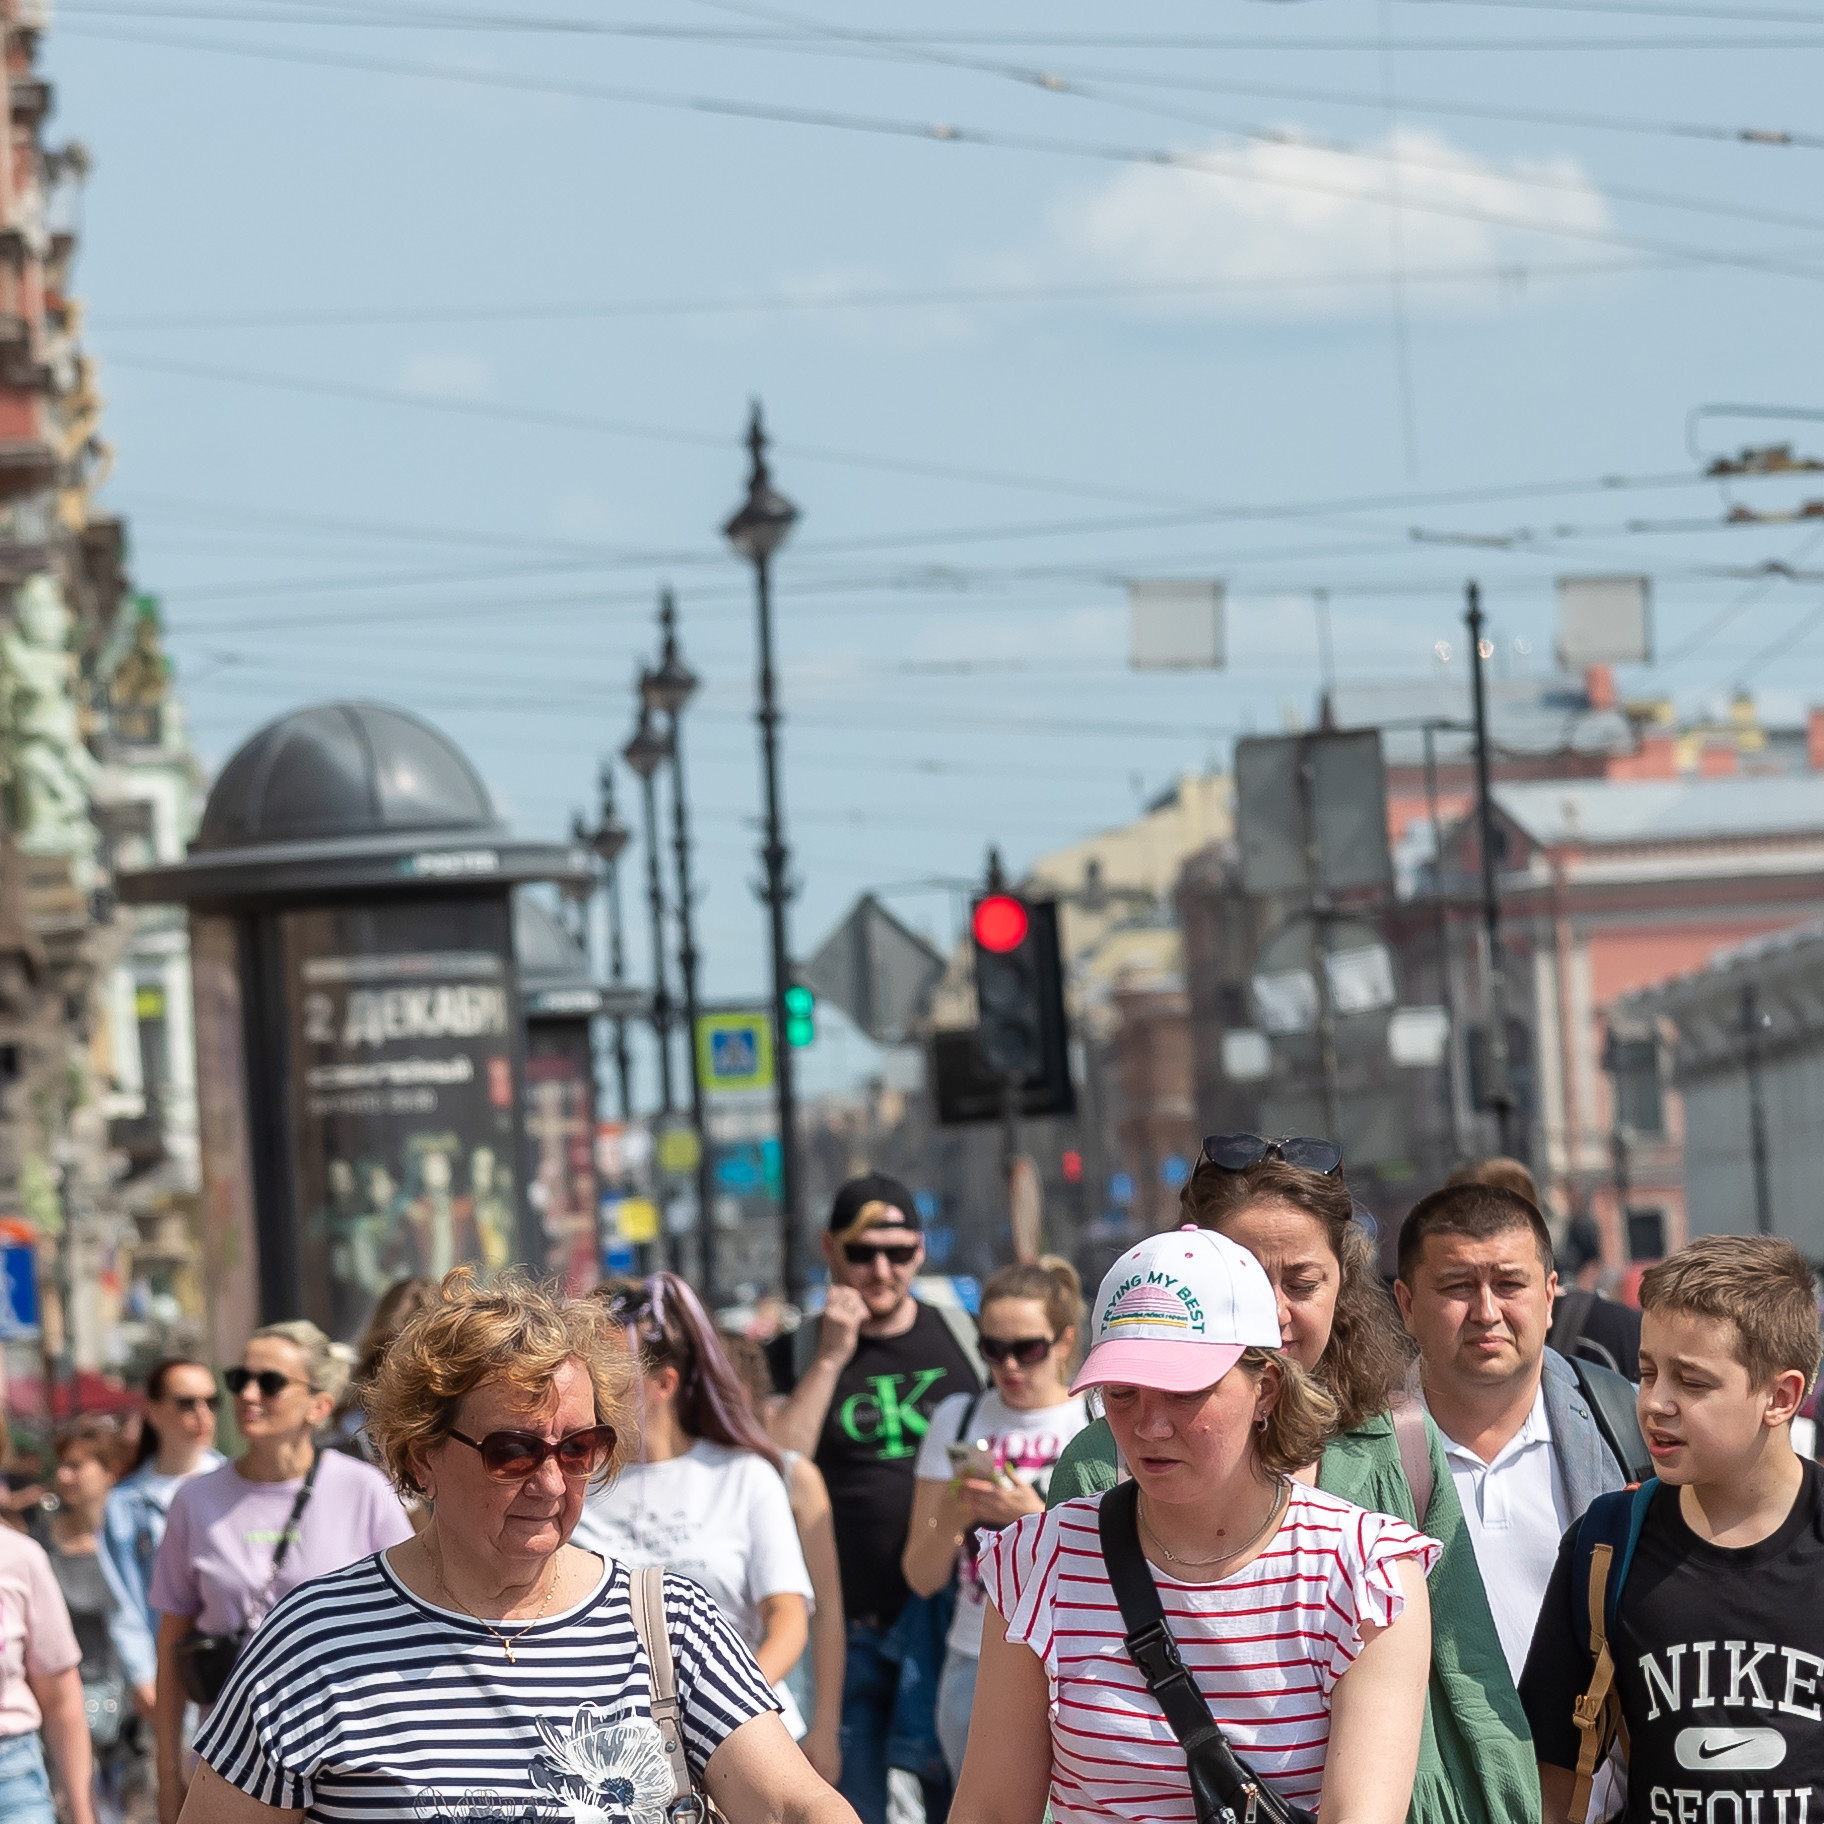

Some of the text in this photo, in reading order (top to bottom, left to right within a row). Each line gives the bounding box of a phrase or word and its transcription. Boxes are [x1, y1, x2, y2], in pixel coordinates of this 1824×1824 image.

[1101, 1270, 1205, 1335] TRYING MY BEST
